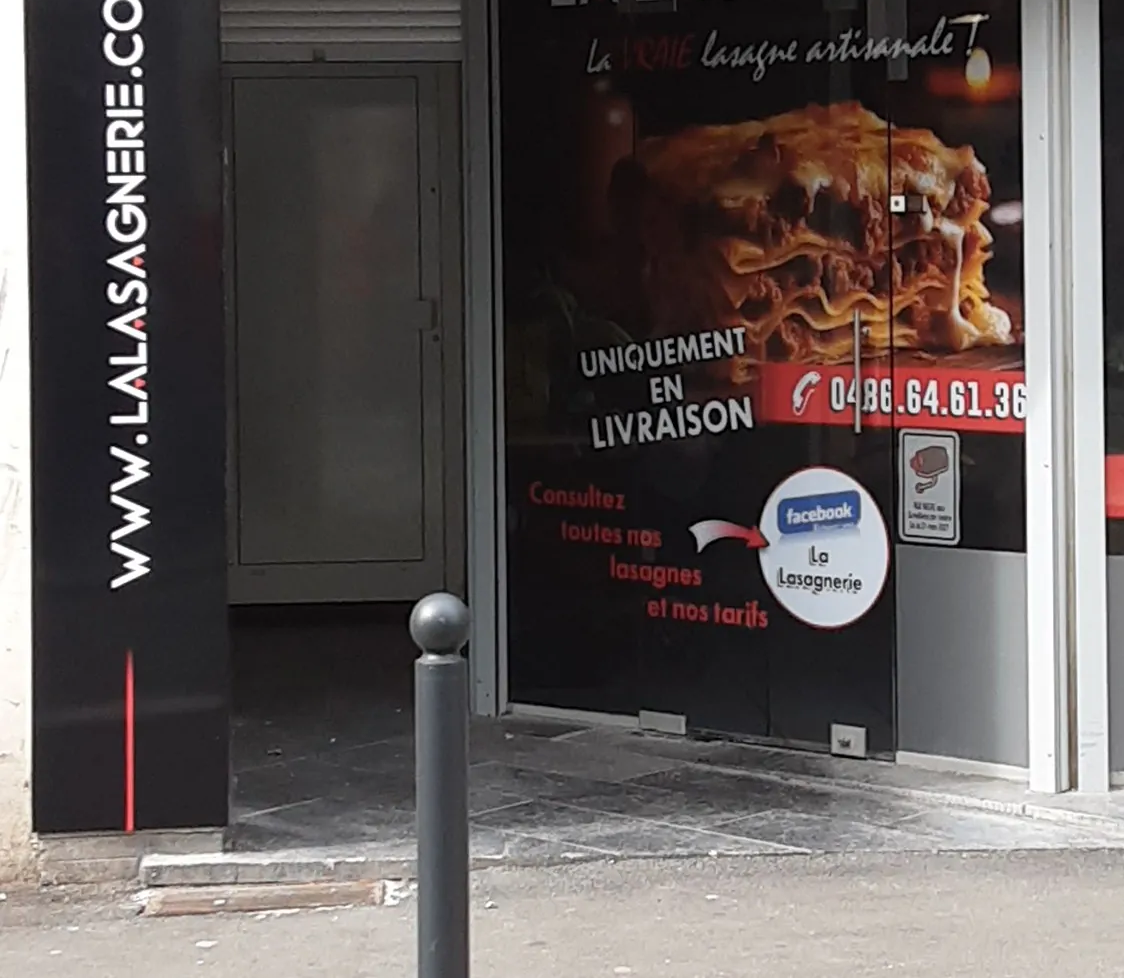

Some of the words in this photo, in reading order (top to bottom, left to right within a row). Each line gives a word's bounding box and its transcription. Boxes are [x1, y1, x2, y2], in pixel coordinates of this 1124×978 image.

[586, 38, 612, 73] La
[700, 29, 798, 82] lasagne
[805, 17, 955, 64] artisanale
[579, 326, 748, 377] UNIQUEMENT
[649, 373, 683, 405] EN
[830, 376, 1027, 419] 0486.64.61.36
[590, 396, 755, 450] LIVRAISON
[529, 481, 627, 512] Consultez
[786, 501, 853, 525] facebook
[561, 520, 624, 547] toutes
[627, 528, 662, 548] nos
[610, 549, 702, 587] lasagnes
[808, 545, 829, 567] La
[777, 566, 863, 595] Lasagnerie
[647, 599, 668, 619] et
[673, 603, 709, 623] nos
[713, 602, 769, 629] tarifs
